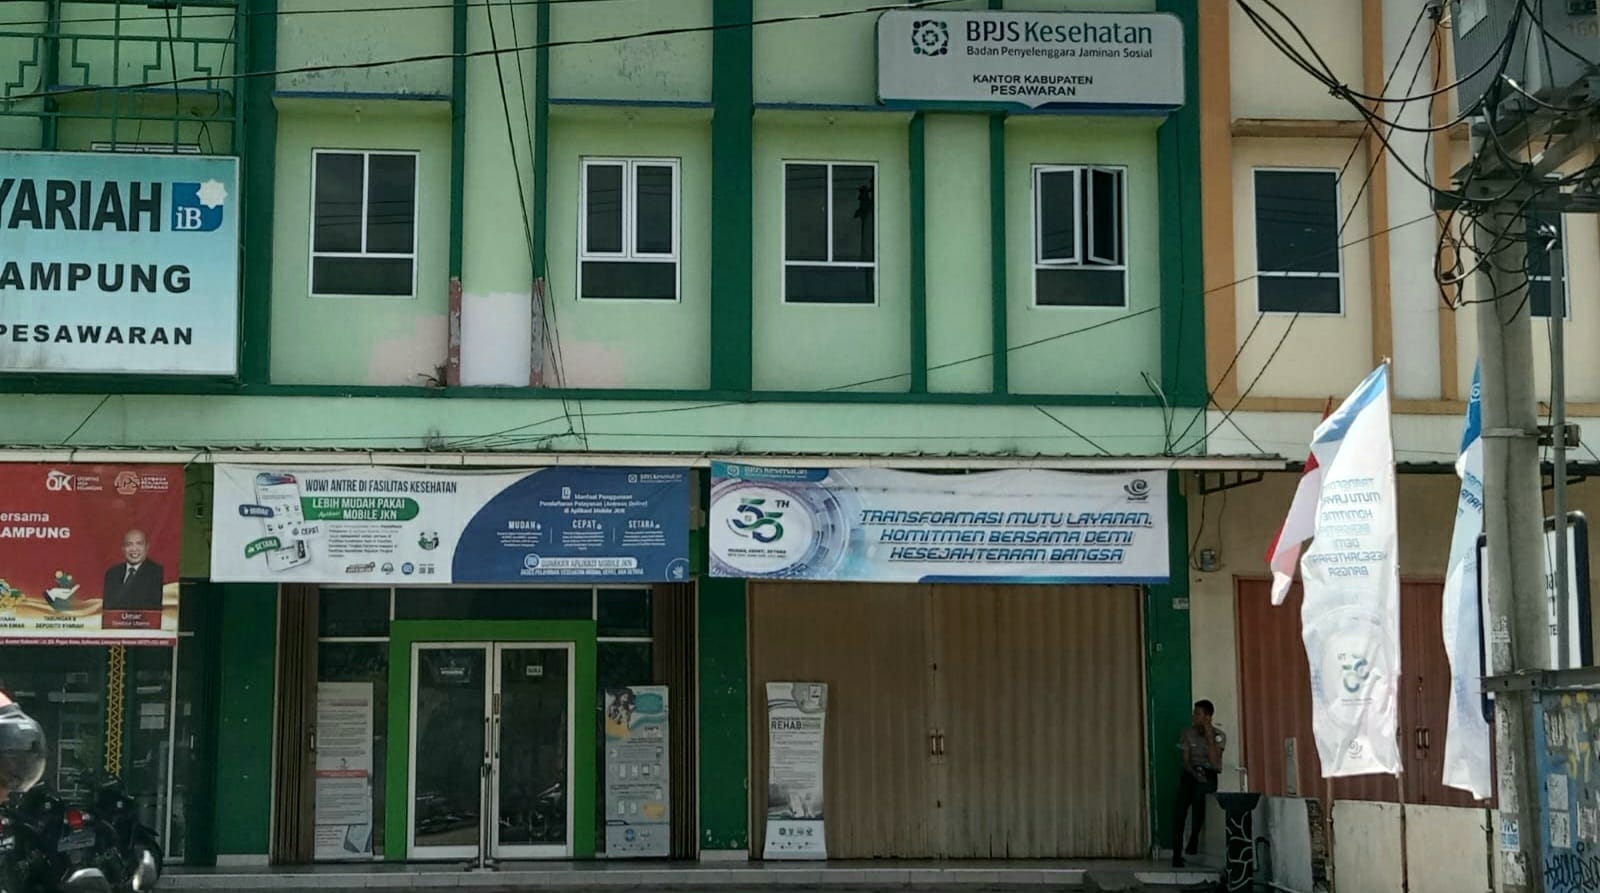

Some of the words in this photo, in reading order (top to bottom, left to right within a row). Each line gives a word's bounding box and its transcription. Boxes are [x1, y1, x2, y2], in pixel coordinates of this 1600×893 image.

[966, 20, 1020, 42] BPJS
[1025, 21, 1152, 44] Kesehatan
[966, 45, 999, 56] Badan
[1001, 45, 1076, 60] Penyelenggara
[1078, 47, 1120, 58] Jaminan
[1123, 48, 1153, 58] Sosial
[973, 74, 1021, 84] KANTOR
[1024, 75, 1093, 85] KABUPATEN
[991, 85, 1076, 97] PESAWARAN
[331, 480, 357, 493] ANTRE
[358, 481, 367, 493] DI
[368, 480, 408, 494] FASILITAS
[410, 481, 457, 494] KESEHATAN
[312, 497, 340, 508] LEBIH
[341, 497, 376, 509] MUDAH
[377, 497, 405, 509] PAKAI
[343, 509, 377, 520] MOBILE
[380, 510, 397, 520] JKN
[861, 509, 1004, 525] TRANSFORMASI
[1007, 510, 1064, 525] MUTU
[572, 520, 597, 529] CEPAT
[880, 529, 986, 543] KOMITMEN
[989, 530, 1081, 544] BERSAMA
[1083, 531, 1133, 544] DEMI
[889, 547, 1049, 561] KESEJAHTERAAN
[1050, 548, 1124, 561] BANGSA
[771, 720, 802, 730] REHAB
